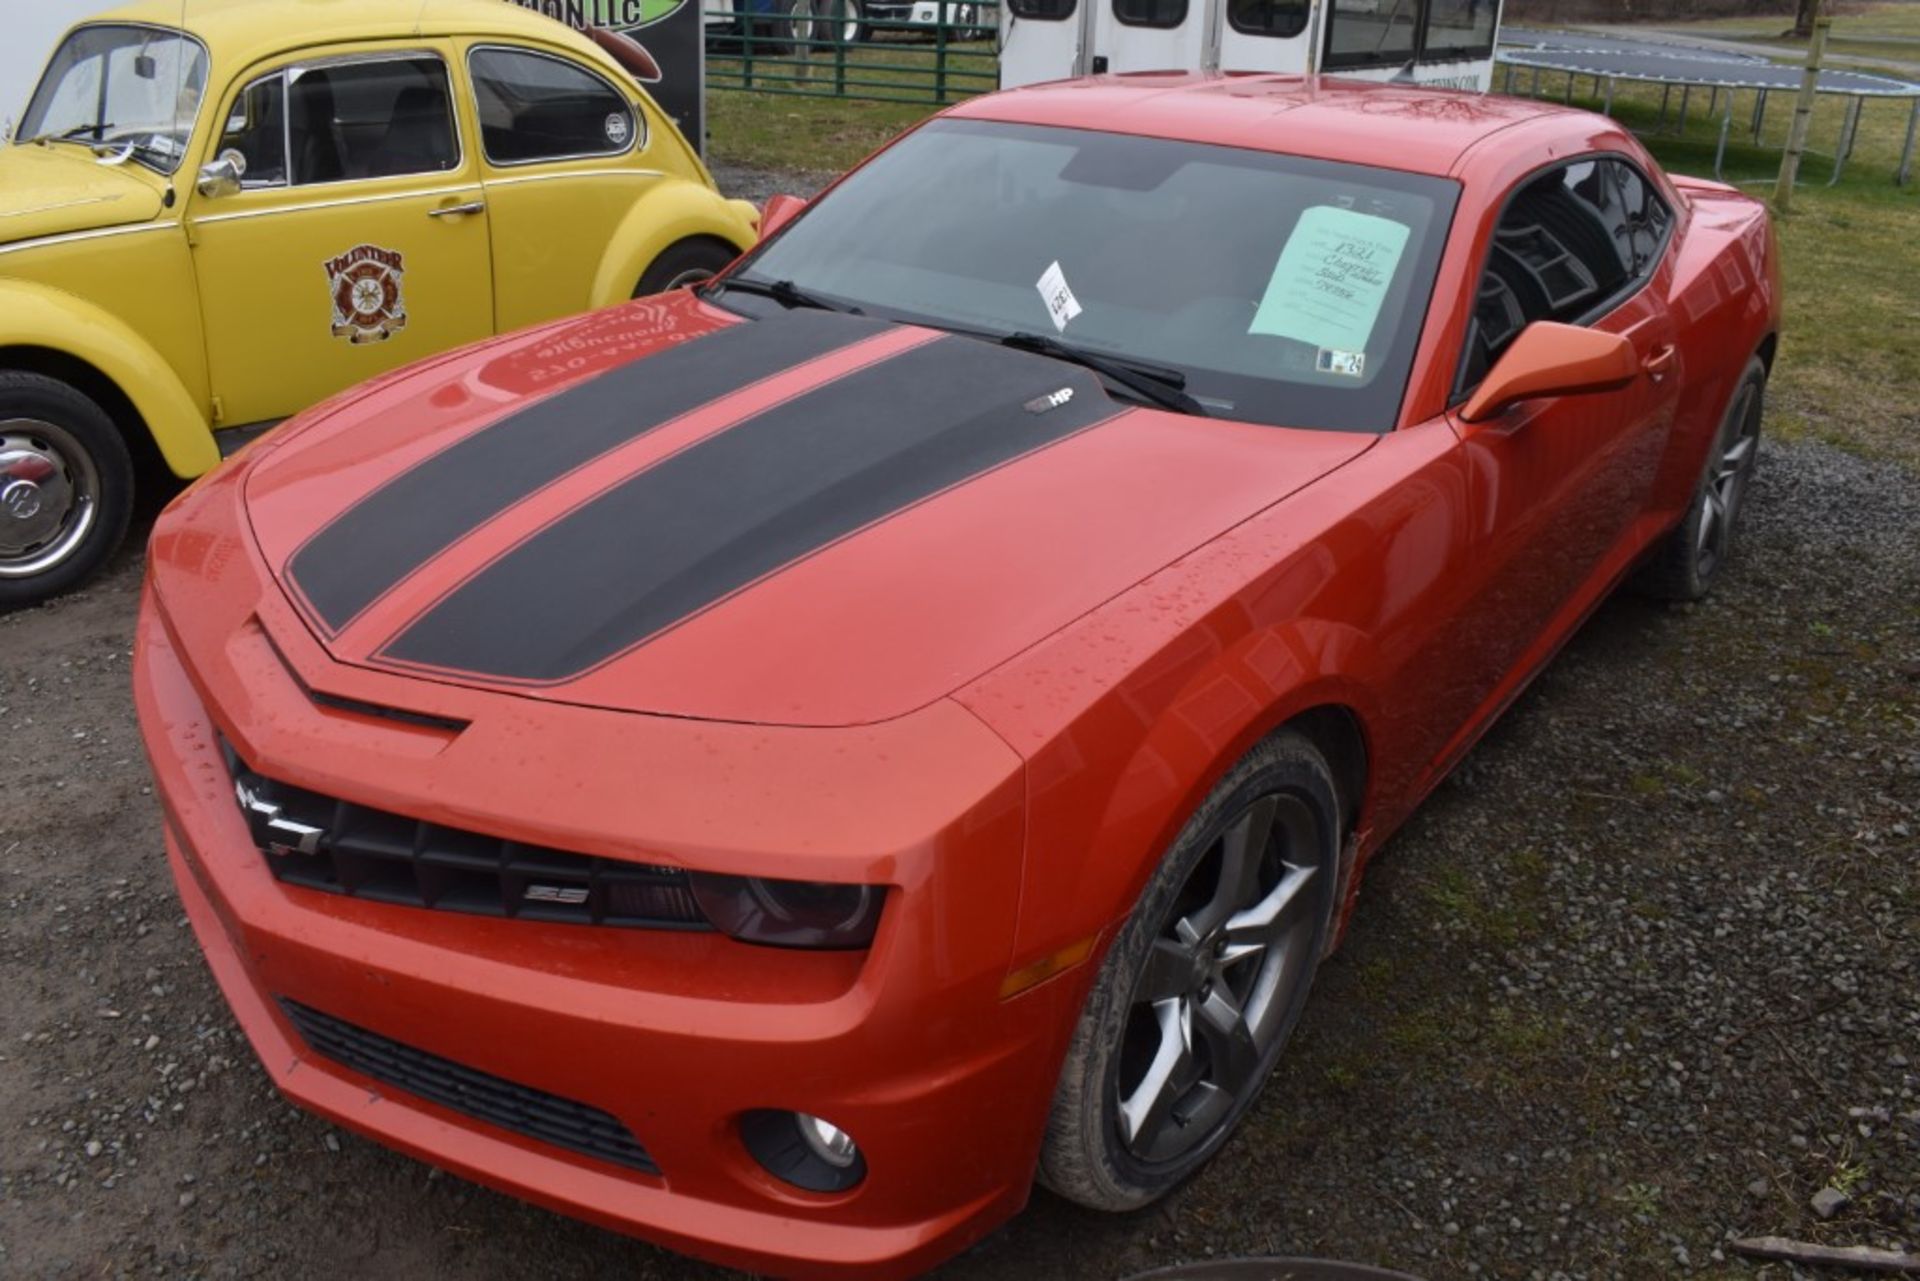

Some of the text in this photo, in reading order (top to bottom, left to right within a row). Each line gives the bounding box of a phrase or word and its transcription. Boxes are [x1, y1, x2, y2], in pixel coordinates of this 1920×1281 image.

[593, 0, 640, 27] LLC
[324, 244, 404, 279] VOLUNTEER
[1048, 388, 1073, 407] HP
